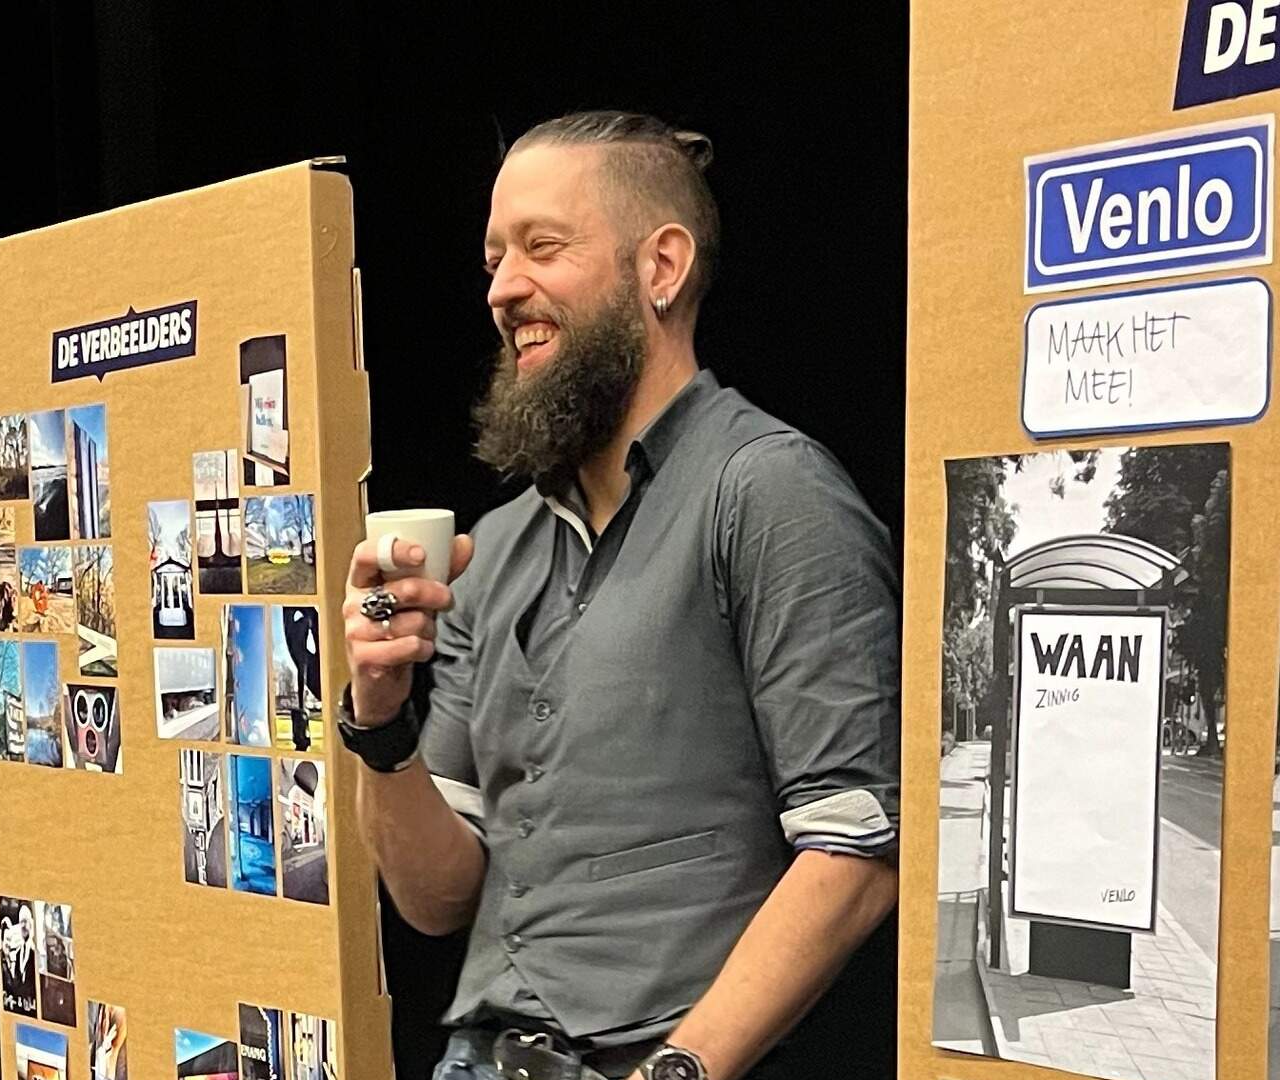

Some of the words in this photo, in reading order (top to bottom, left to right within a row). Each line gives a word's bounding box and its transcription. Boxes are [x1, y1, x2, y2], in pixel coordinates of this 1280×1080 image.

[1203, 0, 1279, 75] DE
[1061, 164, 1233, 256] Venlo
[57, 334, 79, 370] DE
[81, 308, 192, 364] VERBEELDERS
[1048, 319, 1124, 363] MAAK
[1131, 311, 1190, 356] HET
[1064, 368, 1133, 408] MEE!
[1031, 632, 1143, 684] WAAN
[1100, 886, 1136, 905] VENLO
